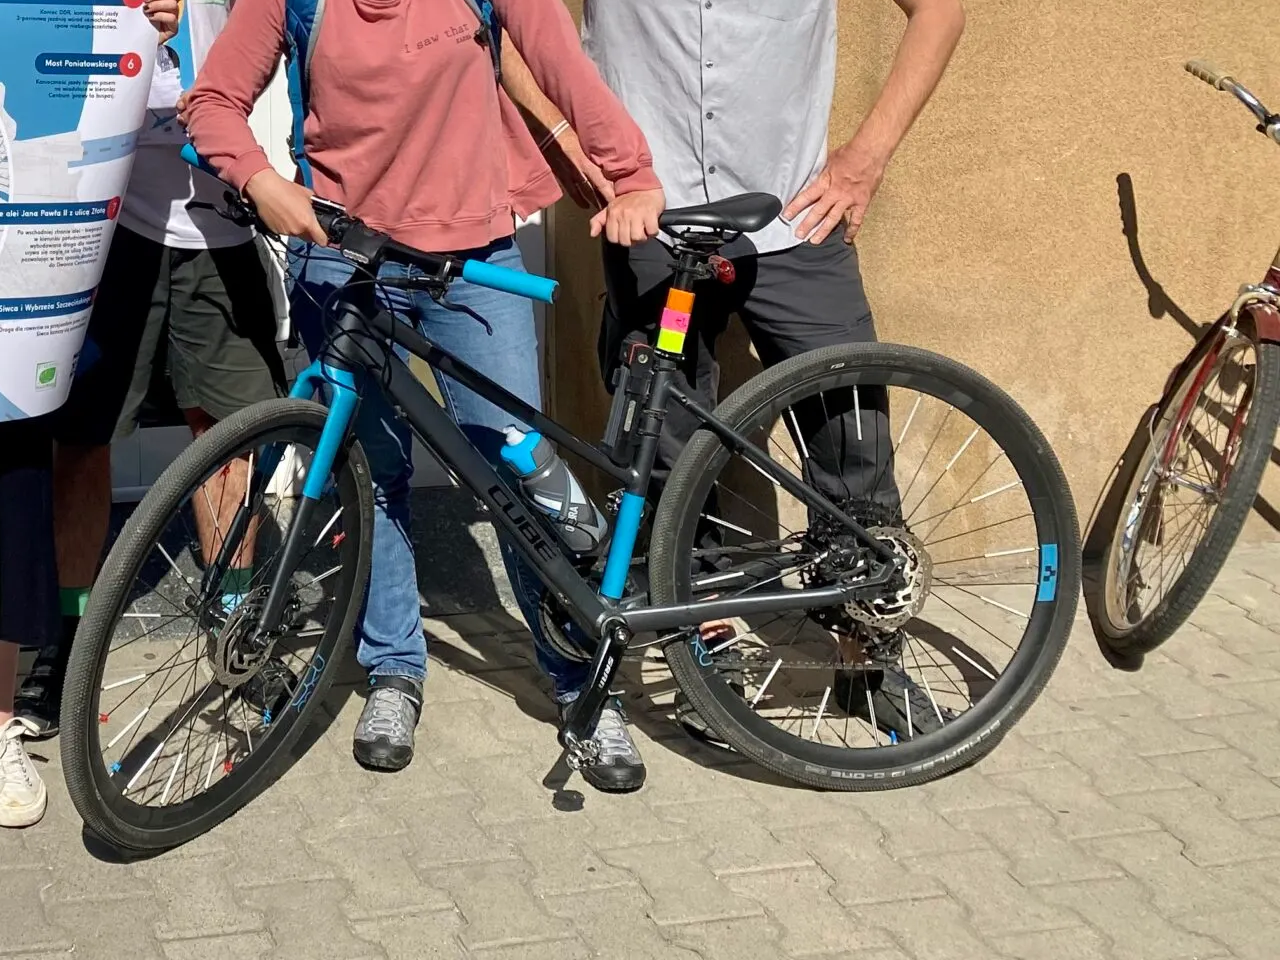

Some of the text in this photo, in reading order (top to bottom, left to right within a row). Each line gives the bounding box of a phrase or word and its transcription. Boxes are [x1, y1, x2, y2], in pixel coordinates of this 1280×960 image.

[404, 23, 469, 54] I saw that
[45, 59, 134, 69] Most Poniatowskiego 6
[5, 208, 19, 218] alei
[21, 209, 38, 218] Jana
[40, 208, 61, 217] Pawła
[24, 303, 55, 313] Wybrzeża
[487, 485, 557, 563] CUBE
[598, 655, 614, 689] SRAM
